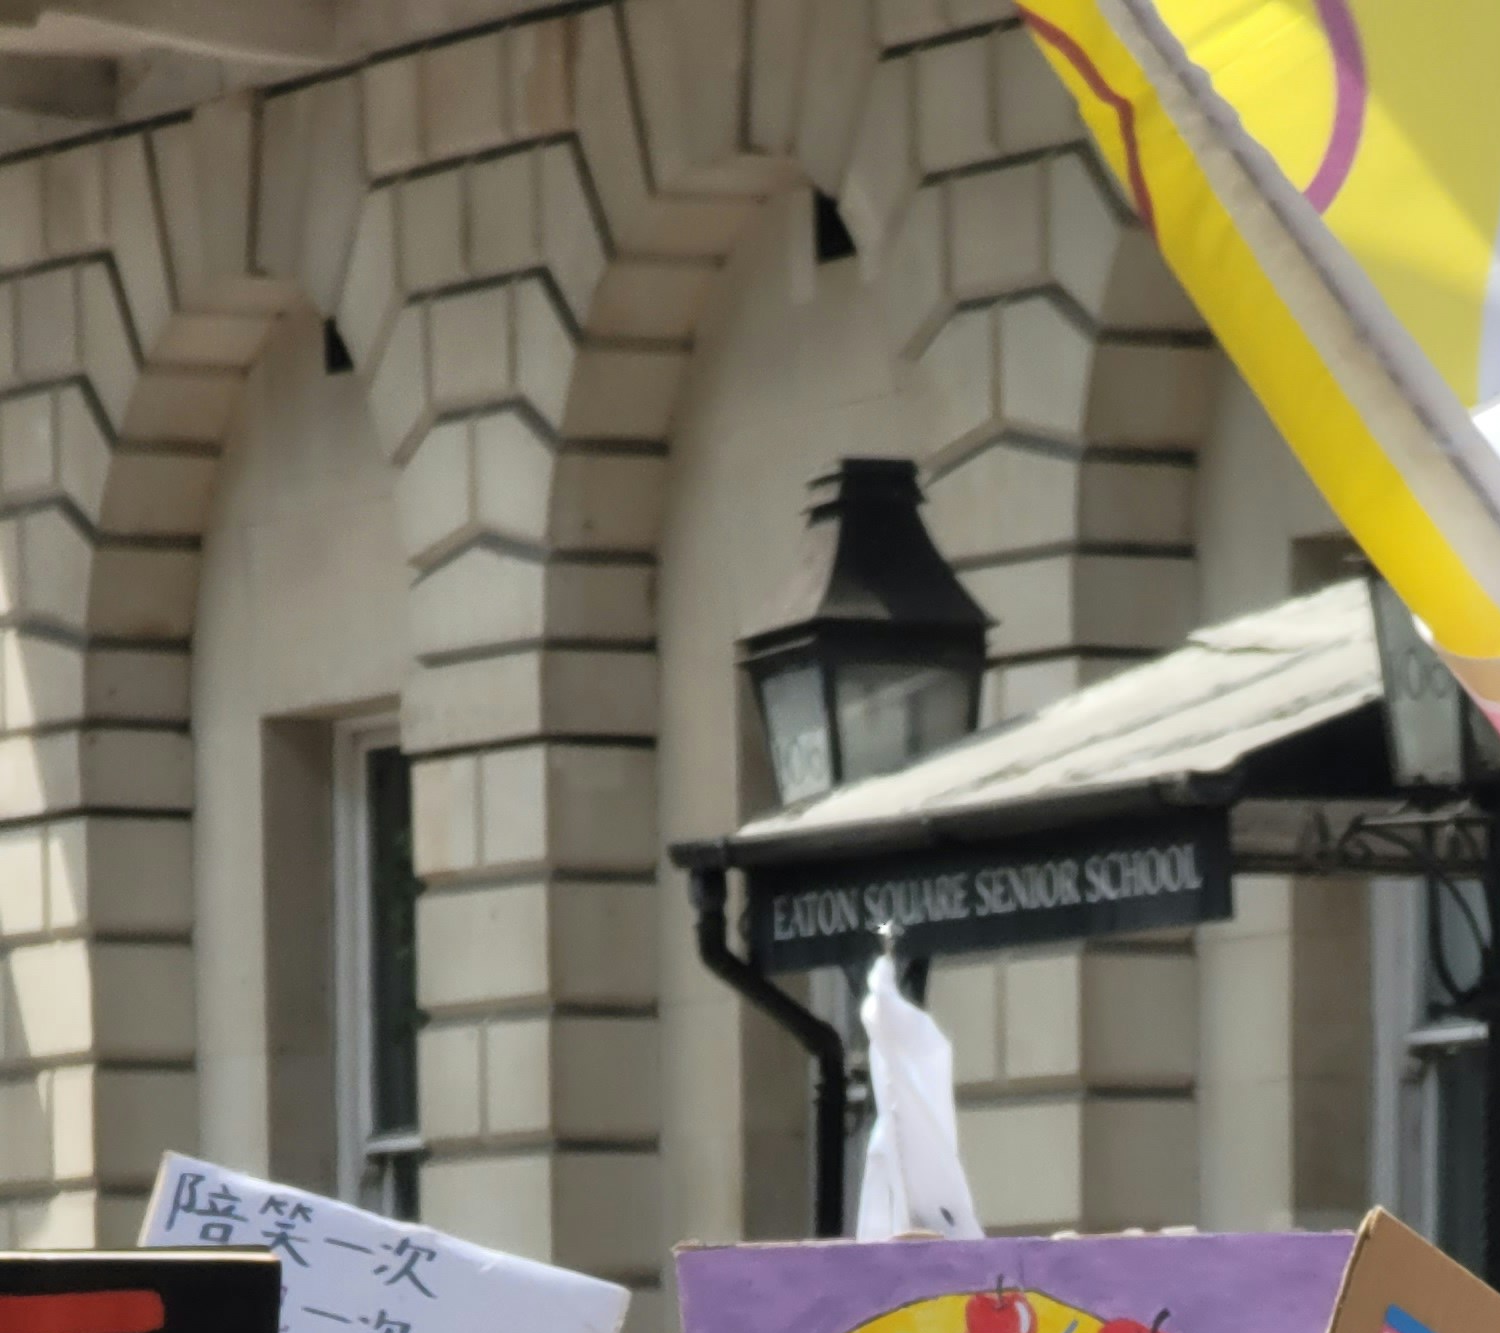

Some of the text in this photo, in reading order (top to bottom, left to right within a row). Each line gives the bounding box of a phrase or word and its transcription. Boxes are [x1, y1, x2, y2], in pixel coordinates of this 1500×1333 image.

[773, 892, 859, 941] EATON
[974, 857, 1081, 917] SENIOR
[1084, 842, 1203, 903] SCHOOL
